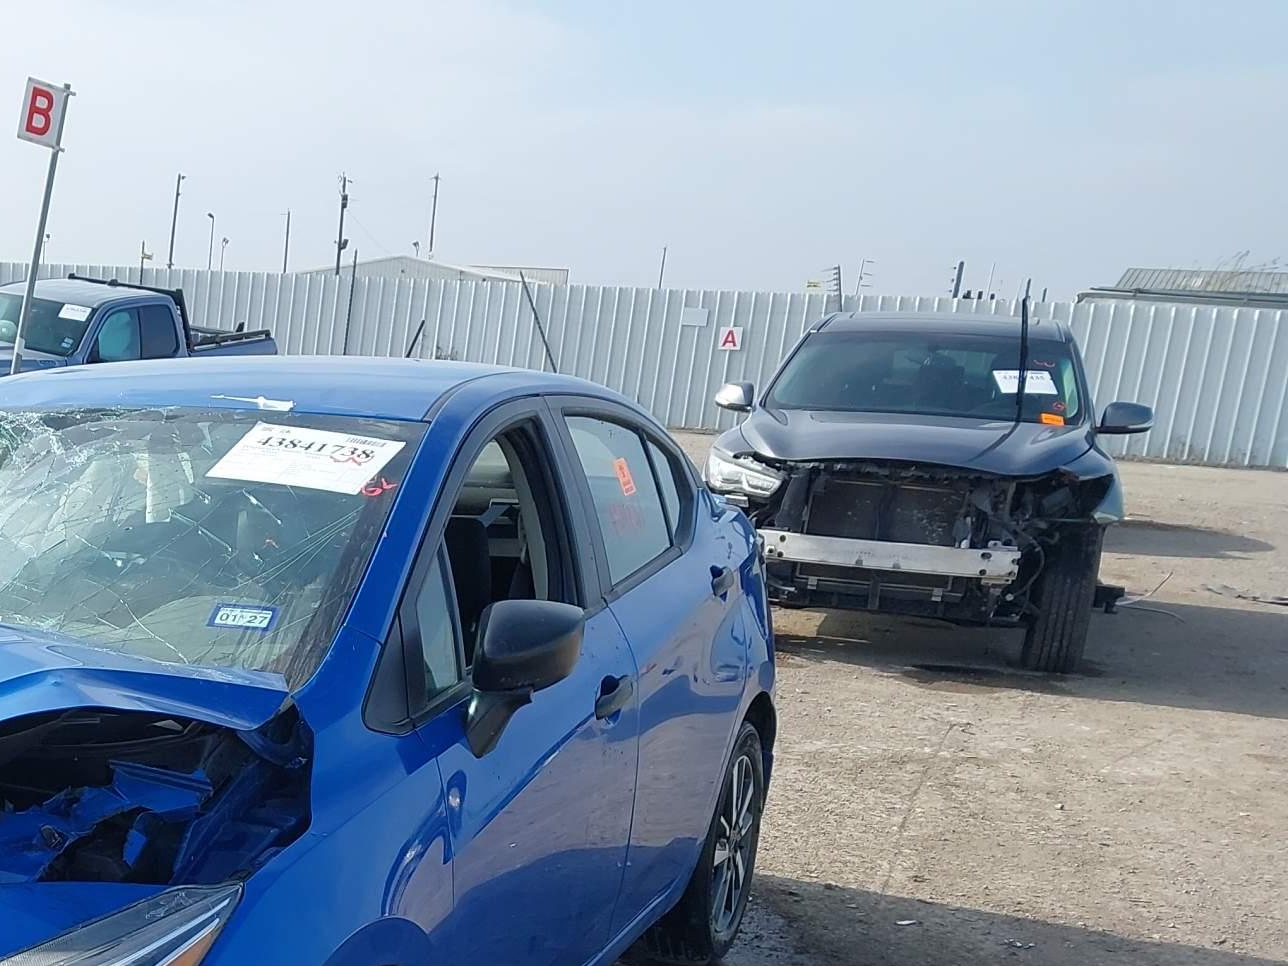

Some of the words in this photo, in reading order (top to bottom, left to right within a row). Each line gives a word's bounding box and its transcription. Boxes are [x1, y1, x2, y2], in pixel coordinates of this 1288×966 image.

[25, 86, 54, 136] B
[722, 329, 737, 347] A
[256, 436, 375, 459] 43841738
[246, 615, 268, 625] 27
